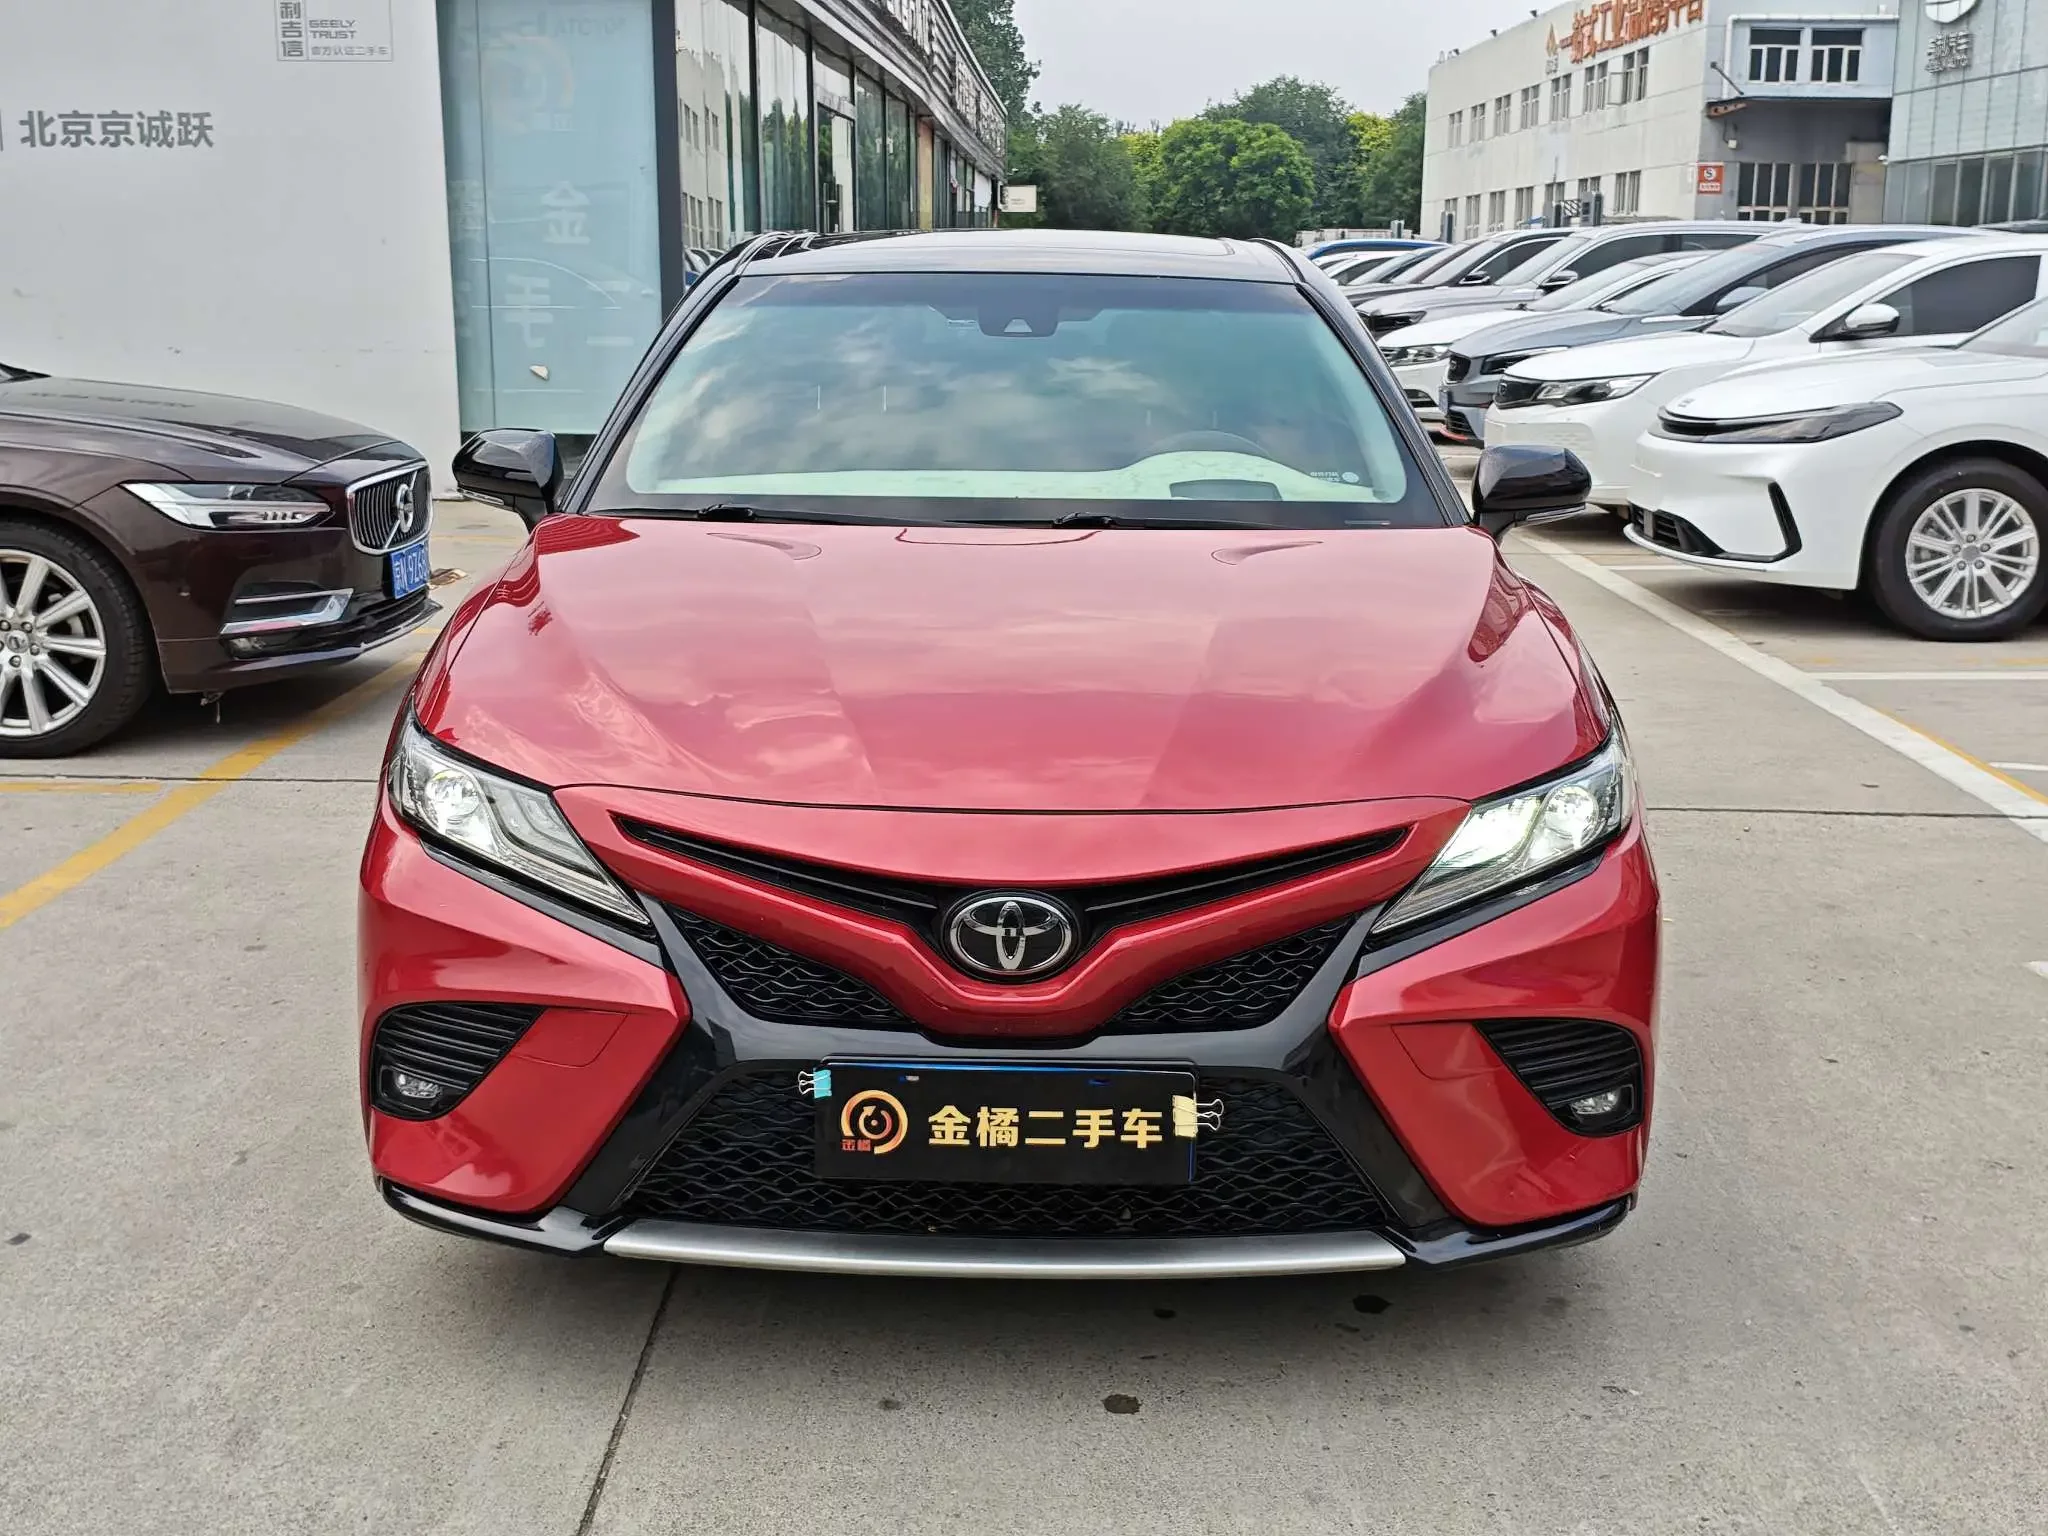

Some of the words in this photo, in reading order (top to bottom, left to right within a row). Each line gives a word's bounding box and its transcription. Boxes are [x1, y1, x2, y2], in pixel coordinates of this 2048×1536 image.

[309, 19, 356, 28] GEELY
[310, 30, 356, 39] TRUST
[19, 110, 214, 148] 北京京诚跃
[928, 1104, 1164, 1149] 金橘二手车
